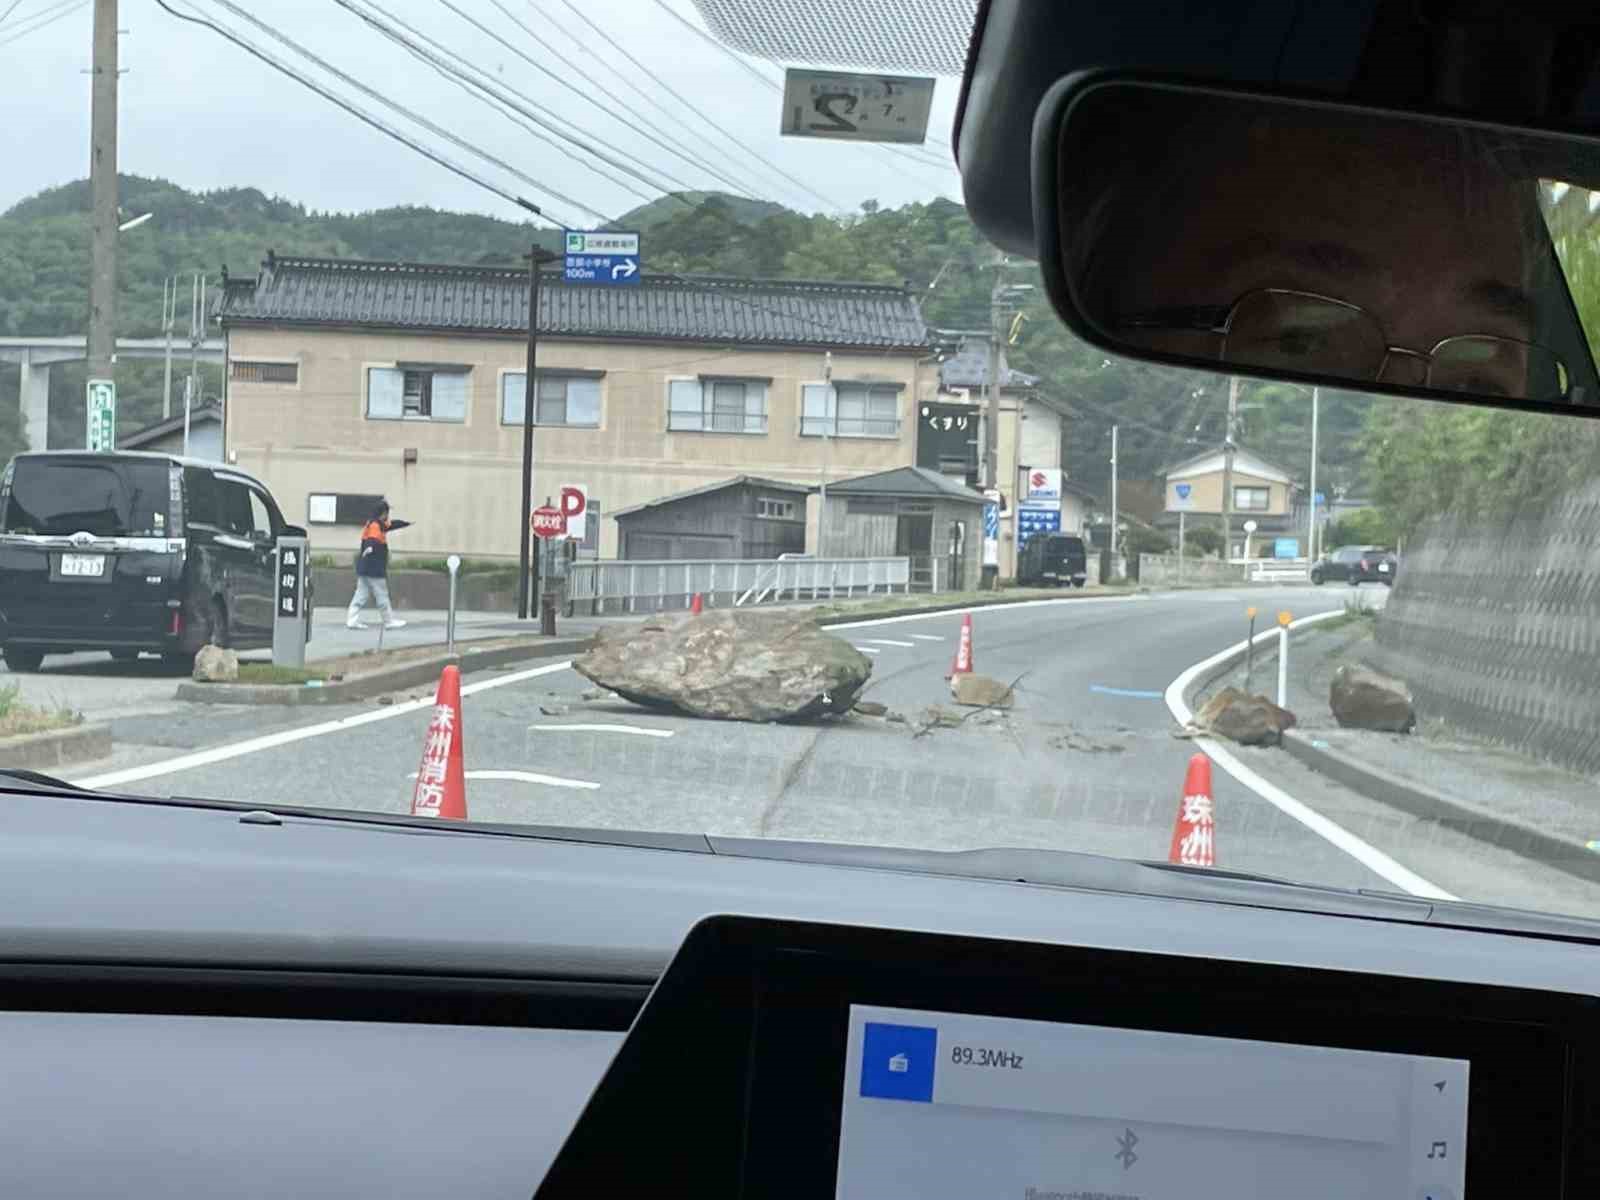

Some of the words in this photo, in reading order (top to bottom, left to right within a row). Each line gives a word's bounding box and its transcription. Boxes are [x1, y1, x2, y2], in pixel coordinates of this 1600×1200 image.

[566, 268, 595, 278] 100m
[929, 416, 968, 430] くすり
[560, 487, 585, 534] P
[951, 1046, 1024, 1070] 89.3MHz
